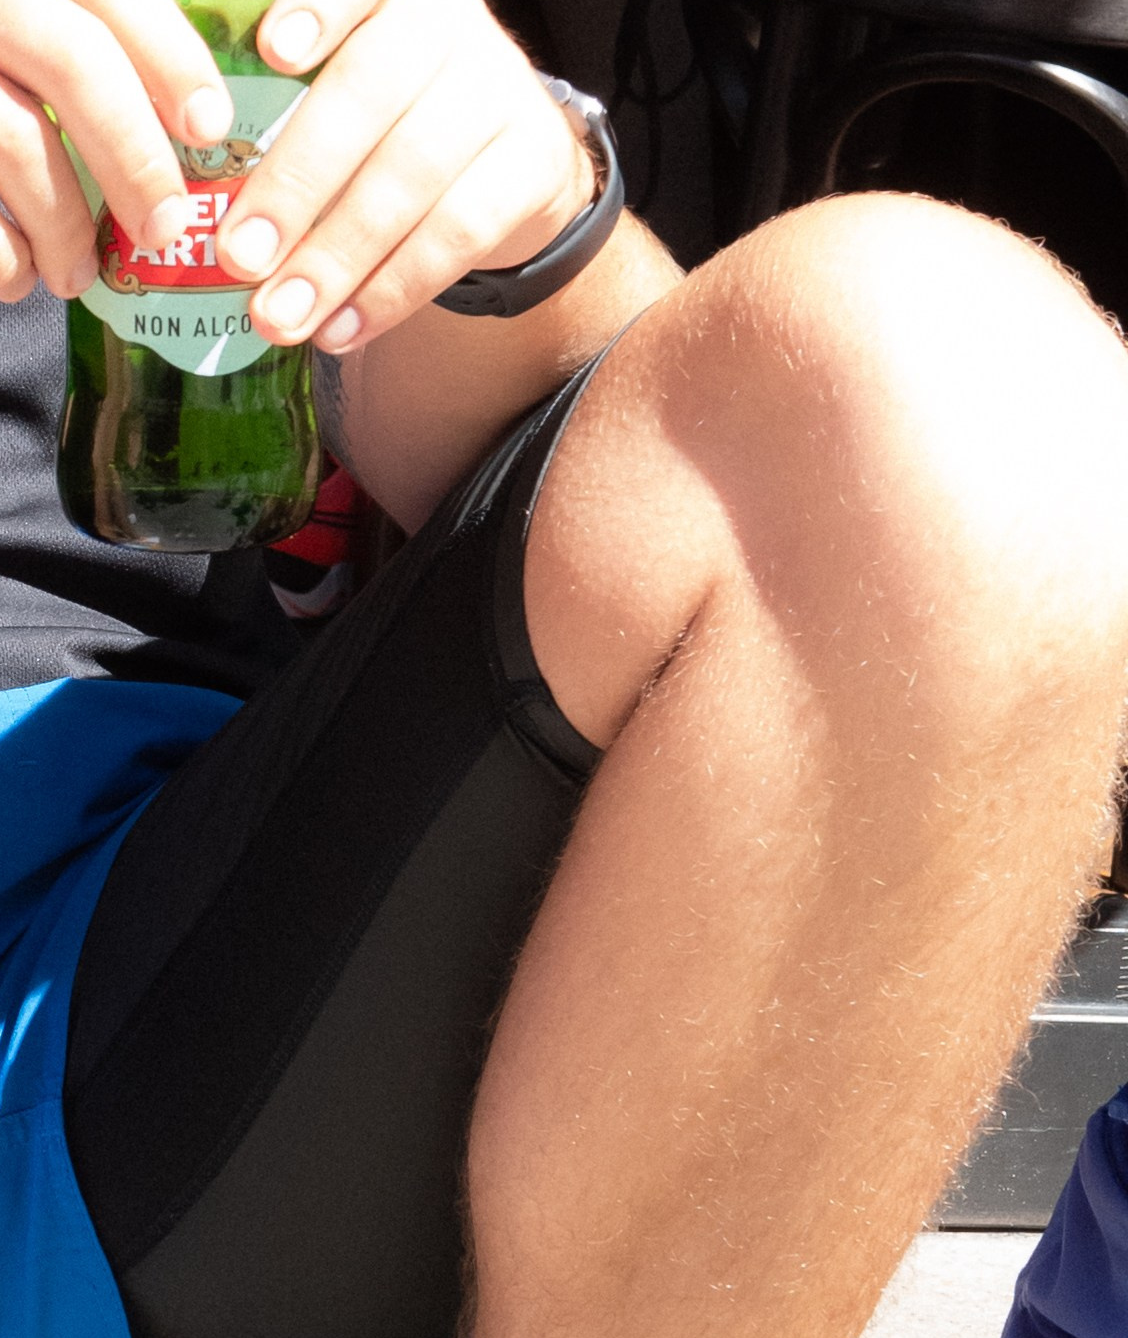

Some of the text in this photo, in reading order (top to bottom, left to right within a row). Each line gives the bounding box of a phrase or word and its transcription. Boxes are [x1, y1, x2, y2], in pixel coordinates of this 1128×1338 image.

[237, 121, 266, 139] 136
[129, 232, 217, 267] ART
[133, 313, 252, 338] NON ALCO
